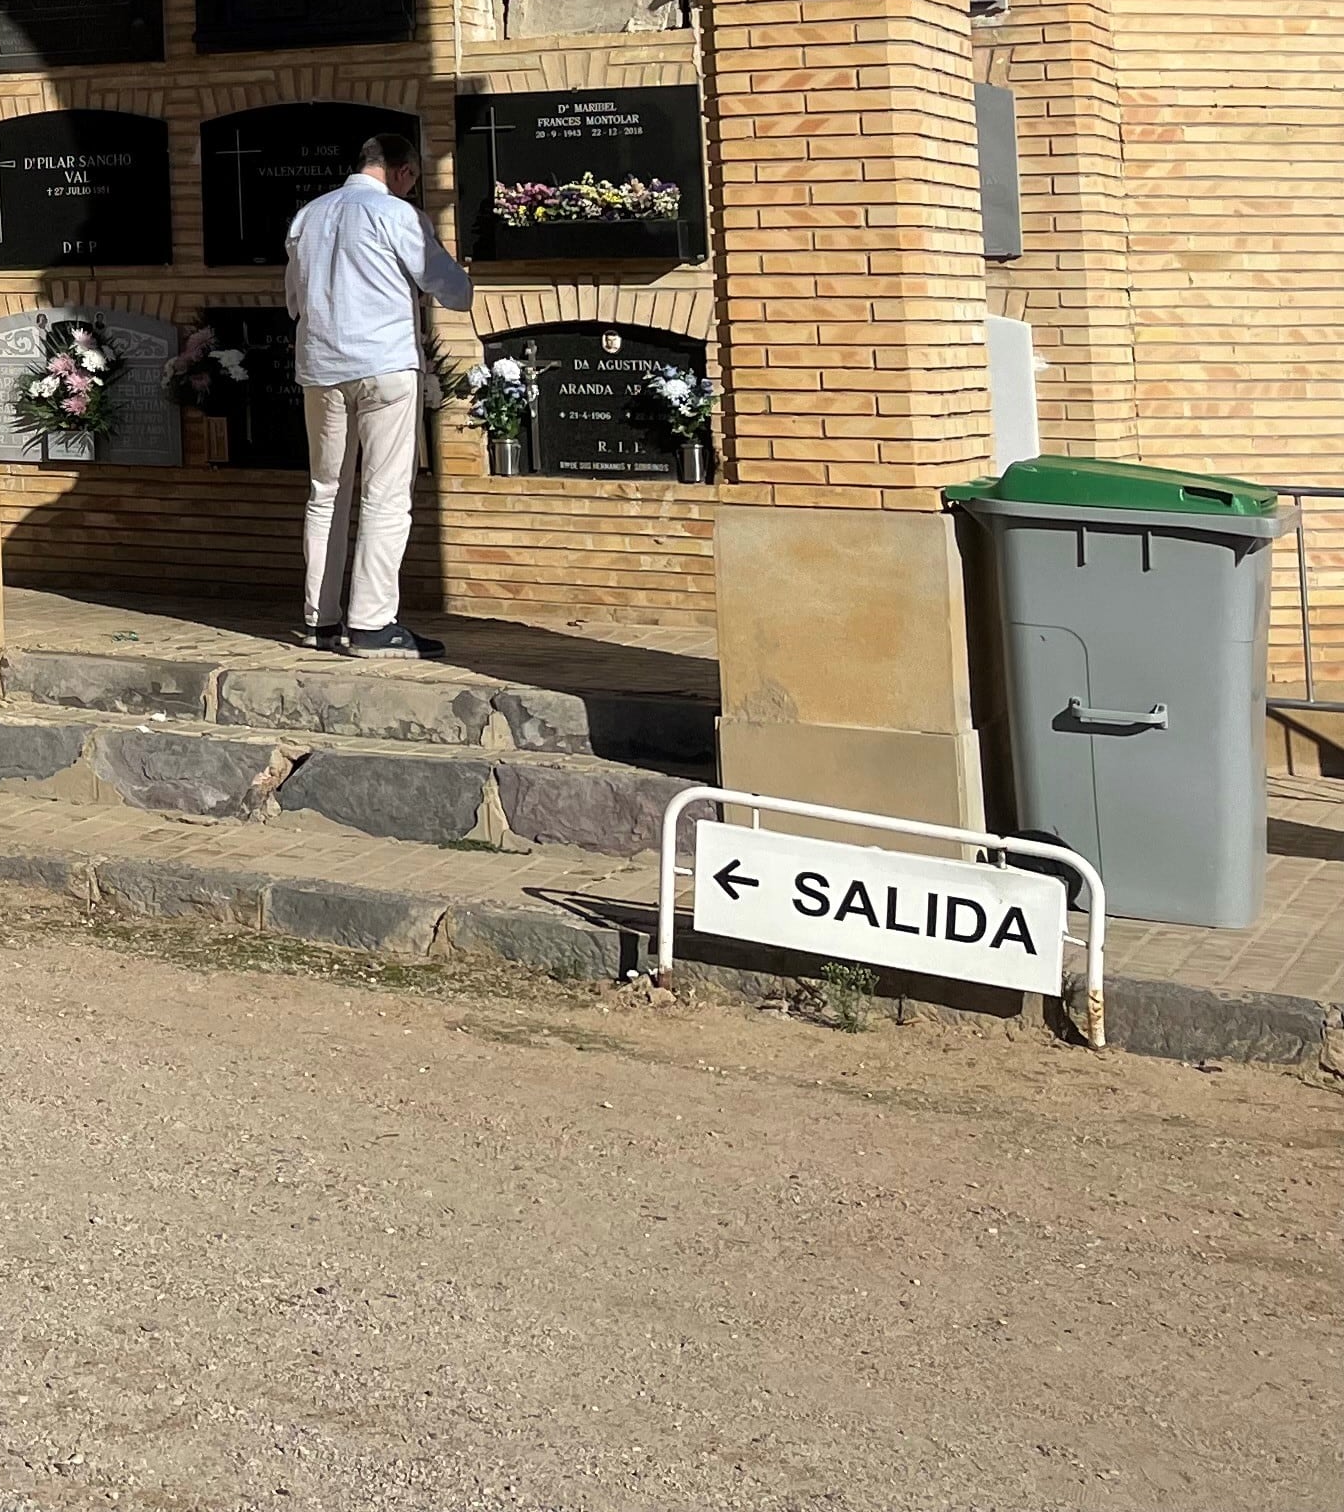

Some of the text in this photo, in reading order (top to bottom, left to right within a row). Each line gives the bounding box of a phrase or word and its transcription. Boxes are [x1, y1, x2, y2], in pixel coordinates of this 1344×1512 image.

[574, 102, 617, 113] MARIBEL
[537, 114, 640, 128] FRANCES MONTOLAR
[313, 145, 340, 156] JOSE
[37, 156, 76, 170] PILAR
[78, 153, 132, 168] SANCHO
[64, 170, 90, 184] VAL
[258, 165, 333, 177] VALENZUELA
[65, 186, 92, 196] JULIO
[63, 241, 97, 254] D E P
[597, 360, 662, 371] AGUSTINA
[559, 384, 614, 395] ARANDA
[792, 872, 1038, 956] SALIDA
